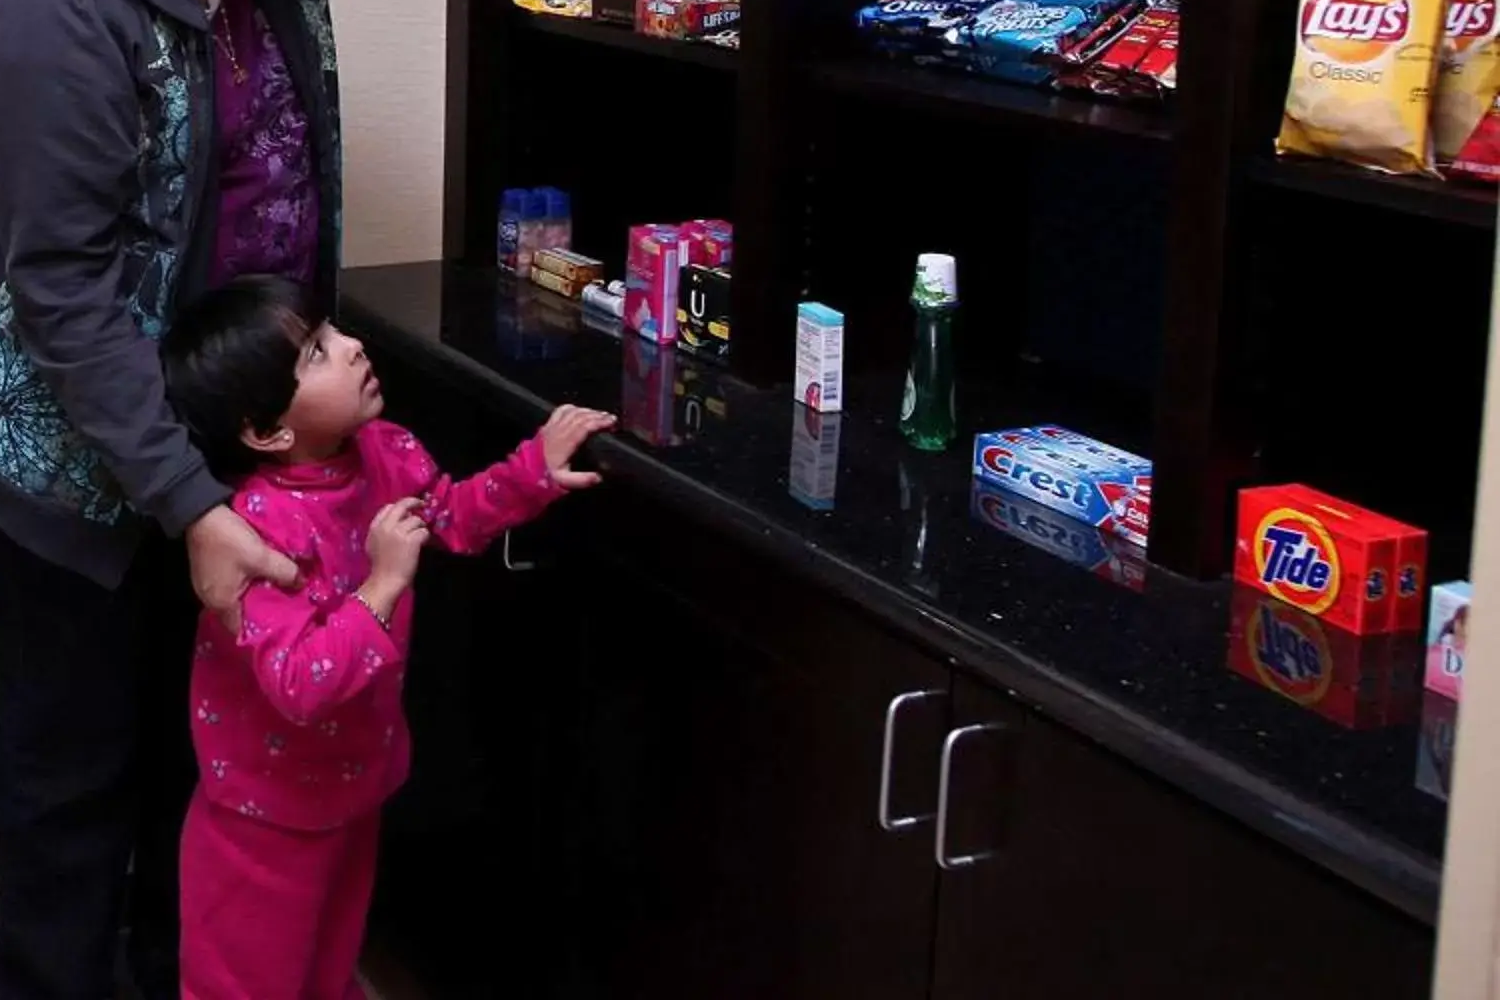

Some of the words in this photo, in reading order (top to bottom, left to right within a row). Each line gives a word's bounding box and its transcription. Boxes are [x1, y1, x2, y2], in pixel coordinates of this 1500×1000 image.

[1309, 61, 1383, 85] Classic
[982, 445, 1094, 510] Crest
[1262, 524, 1332, 590] Tide
